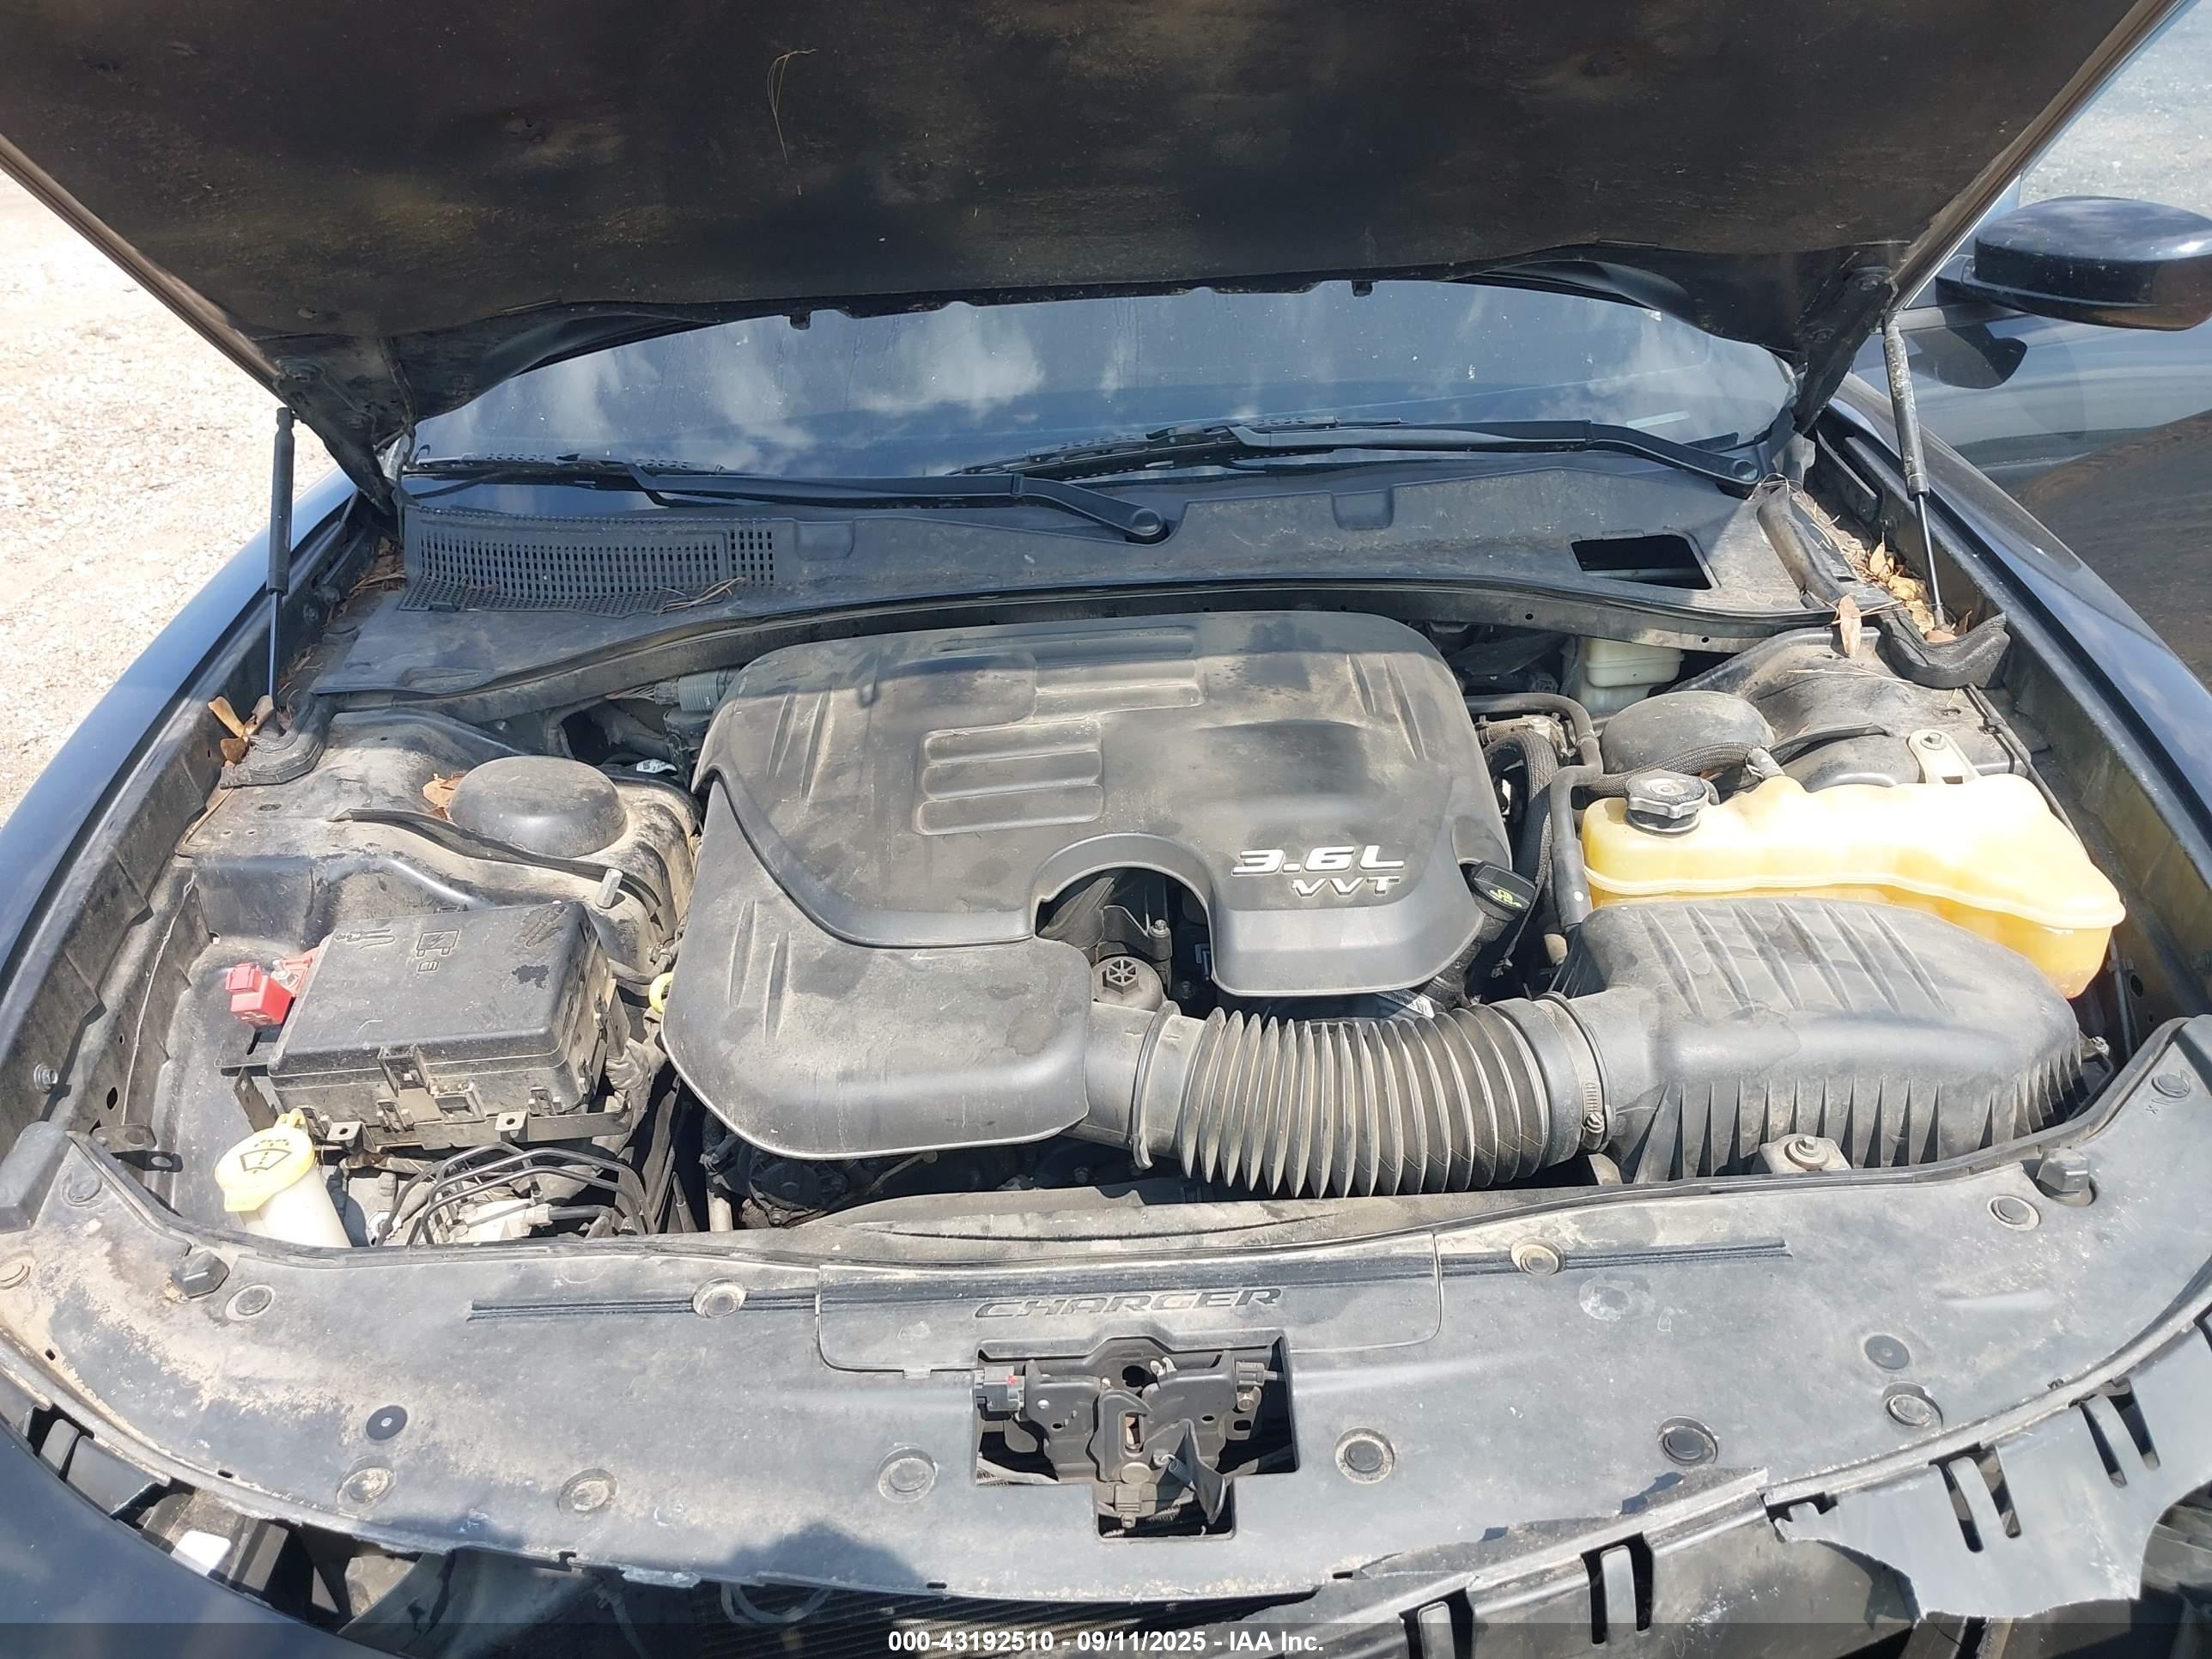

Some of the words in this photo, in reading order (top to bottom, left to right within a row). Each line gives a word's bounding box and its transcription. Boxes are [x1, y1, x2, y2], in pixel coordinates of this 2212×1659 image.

[1231, 845, 1405, 876] 3.6L
[1291, 875, 1401, 896] VVT
[974, 1288, 1283, 1318] CHARGER
